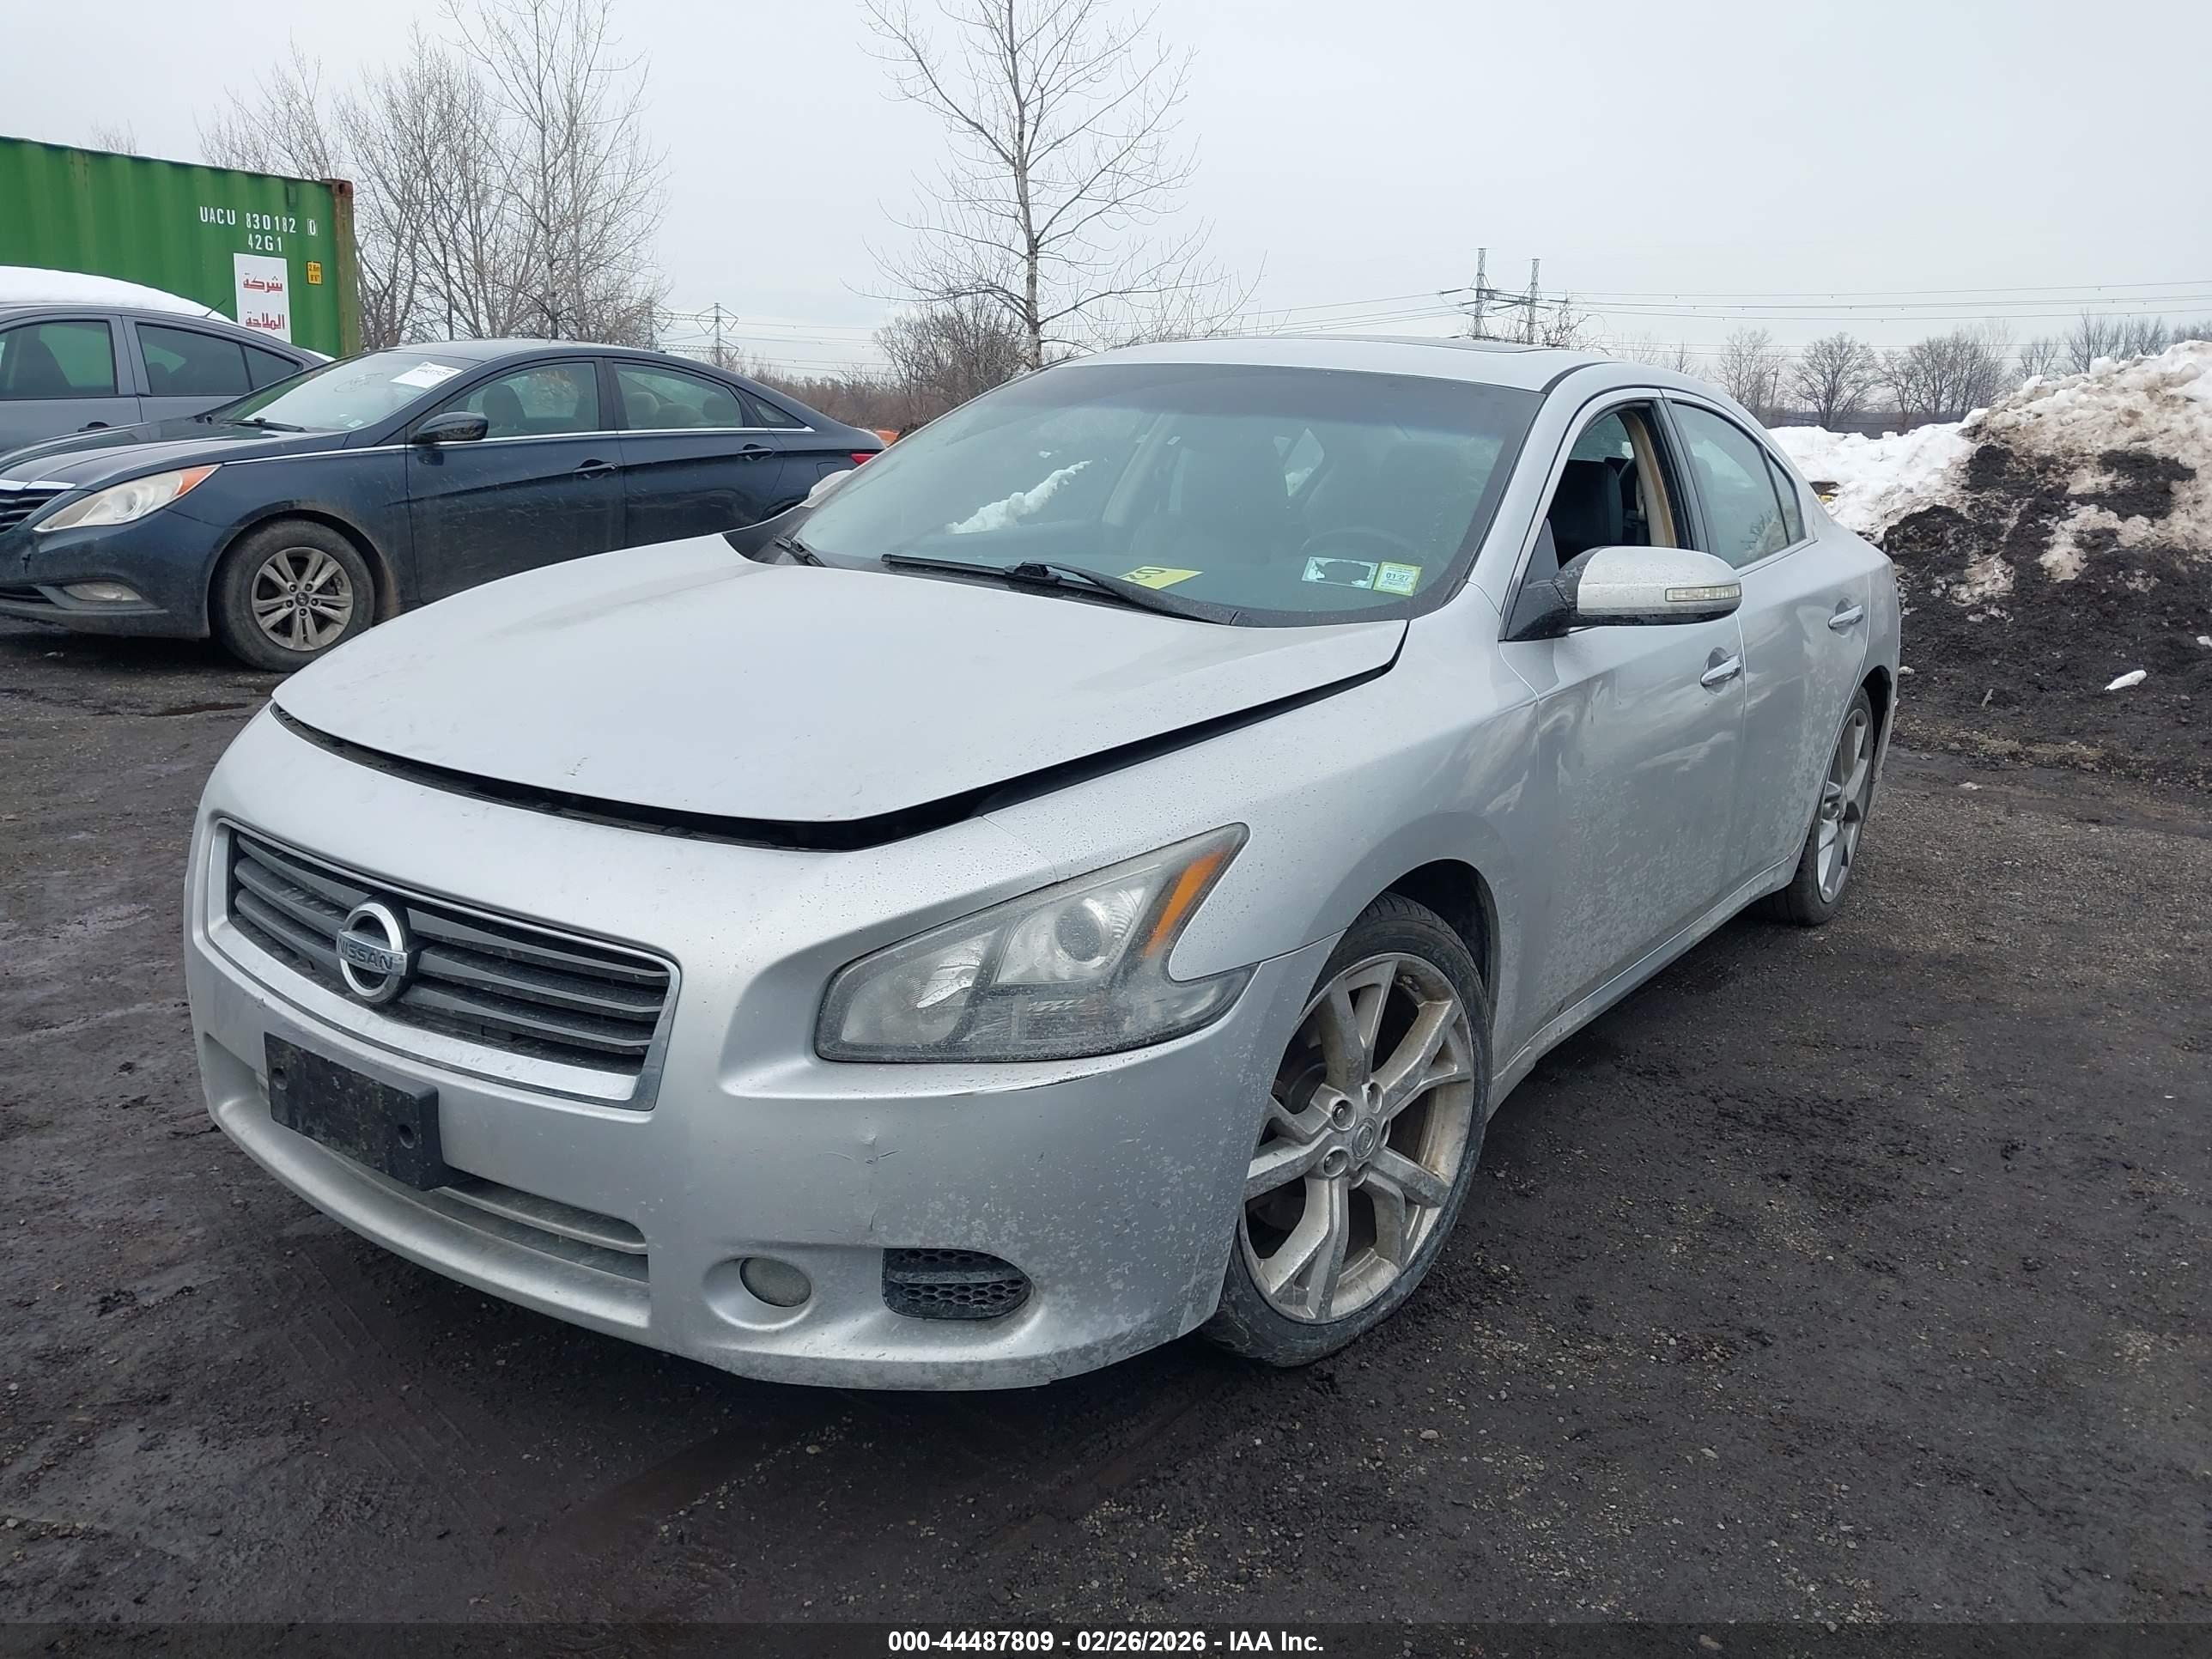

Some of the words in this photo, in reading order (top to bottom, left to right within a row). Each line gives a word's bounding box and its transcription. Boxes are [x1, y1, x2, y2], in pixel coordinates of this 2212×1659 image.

[199, 206, 236, 226] UACU
[246, 212, 297, 234] 830182
[247, 233, 283, 252] 42G1
[243, 272, 283, 293] شركة
[245, 311, 285, 331] الملاحة
[337, 937, 393, 971] NISSAN
